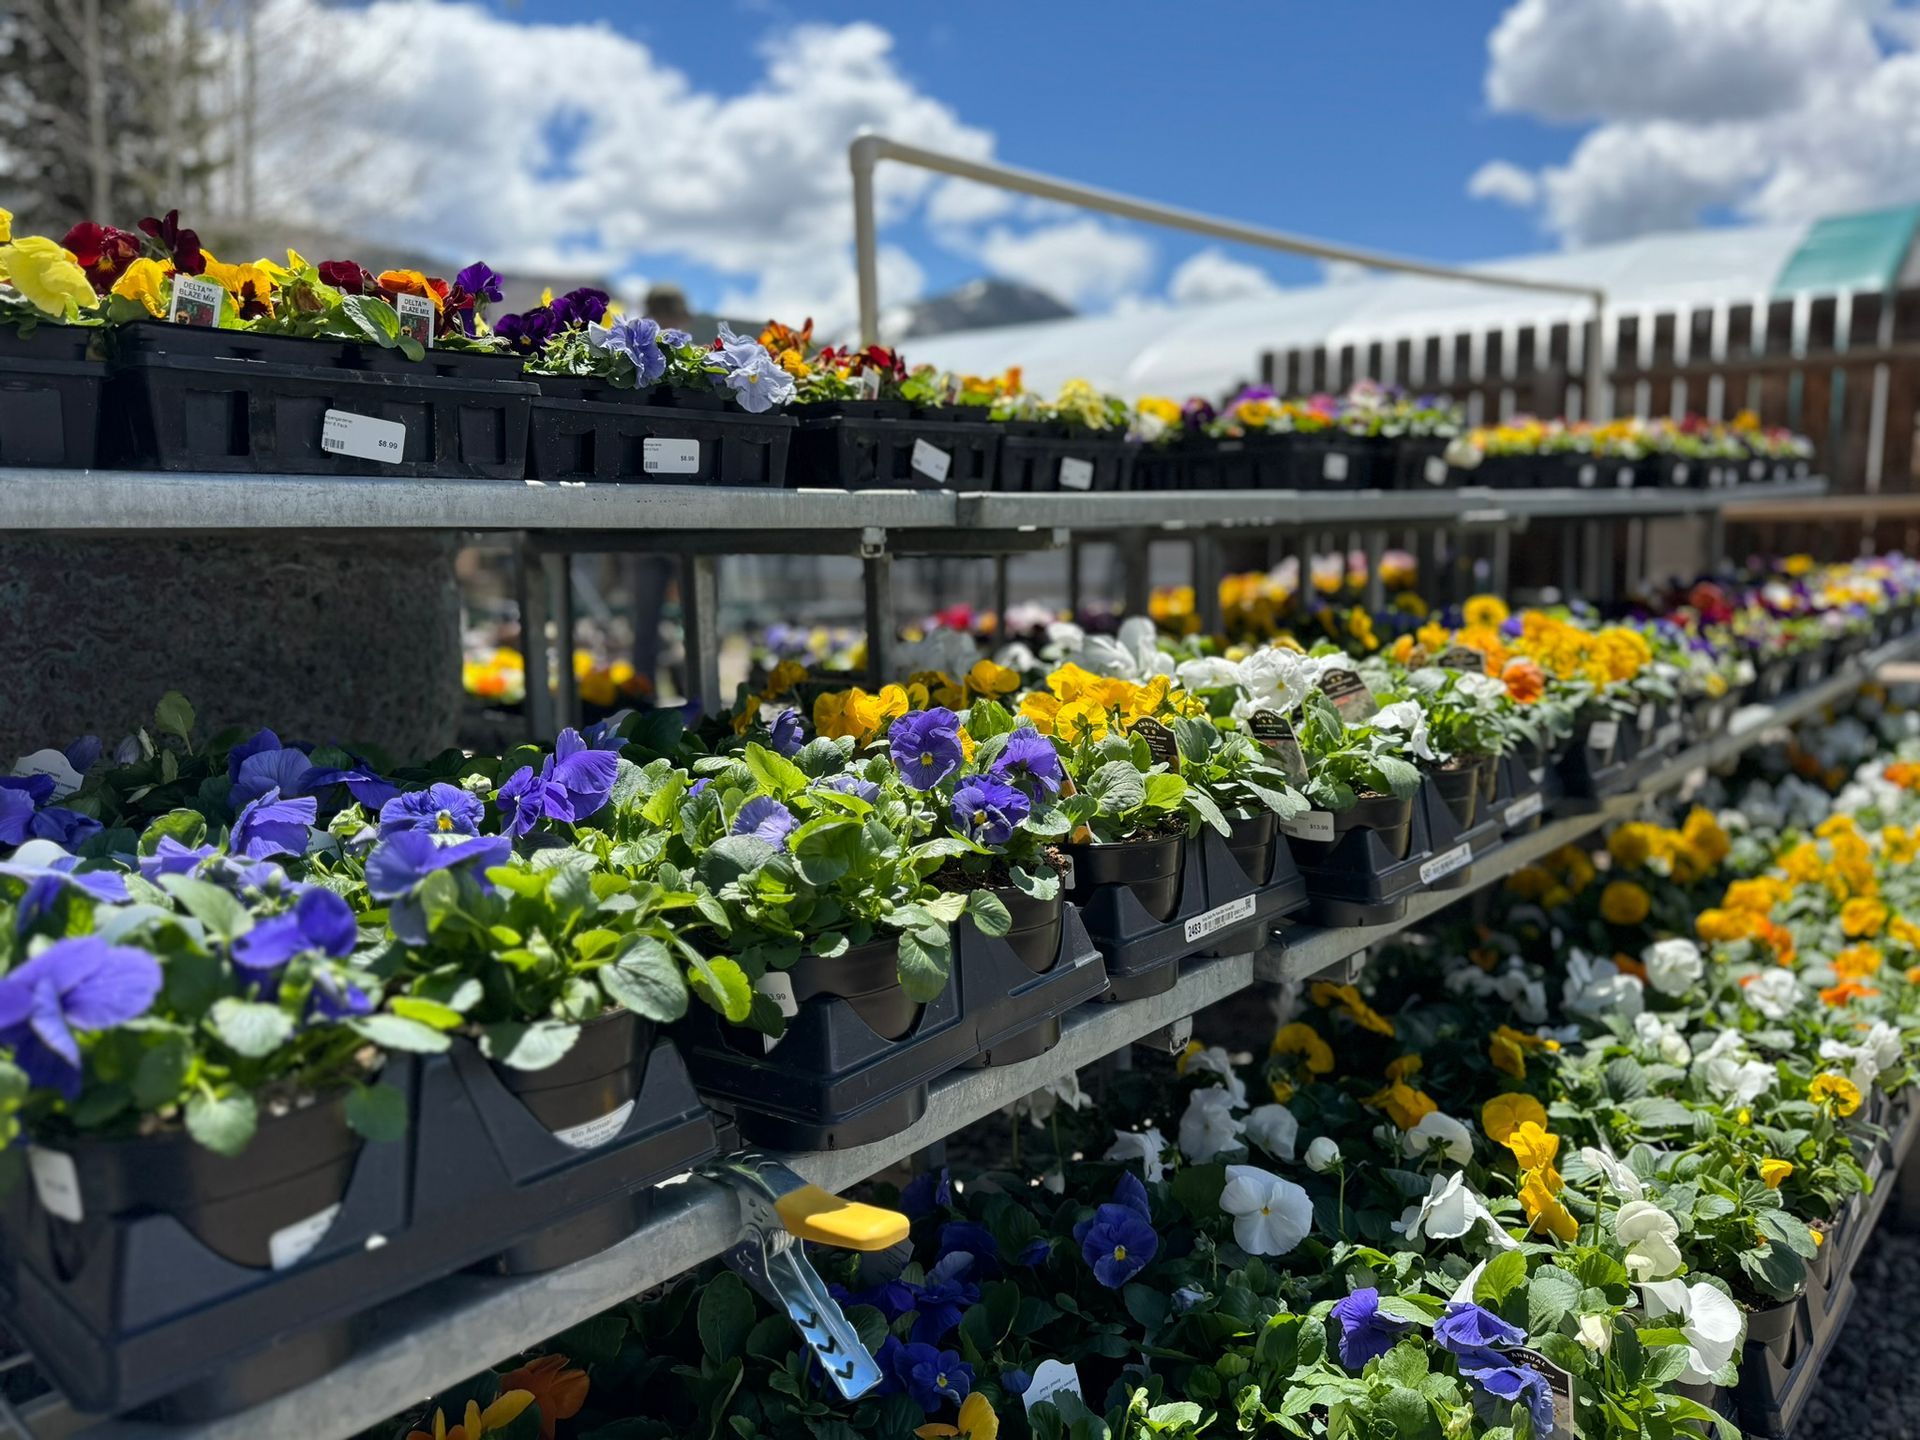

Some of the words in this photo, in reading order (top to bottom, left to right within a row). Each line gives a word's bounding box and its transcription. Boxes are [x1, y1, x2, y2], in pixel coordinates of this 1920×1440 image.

[179, 288, 201, 300] BLAZE
[202, 294, 215, 303] MIX
[401, 304, 419, 313] BLAZE
[378, 440, 398, 449] $8.99
[1138, 721, 1160, 730] ANNUAL
[1188, 922, 1201, 937] 2483
[1511, 1352, 1546, 1367] ANNUAL
